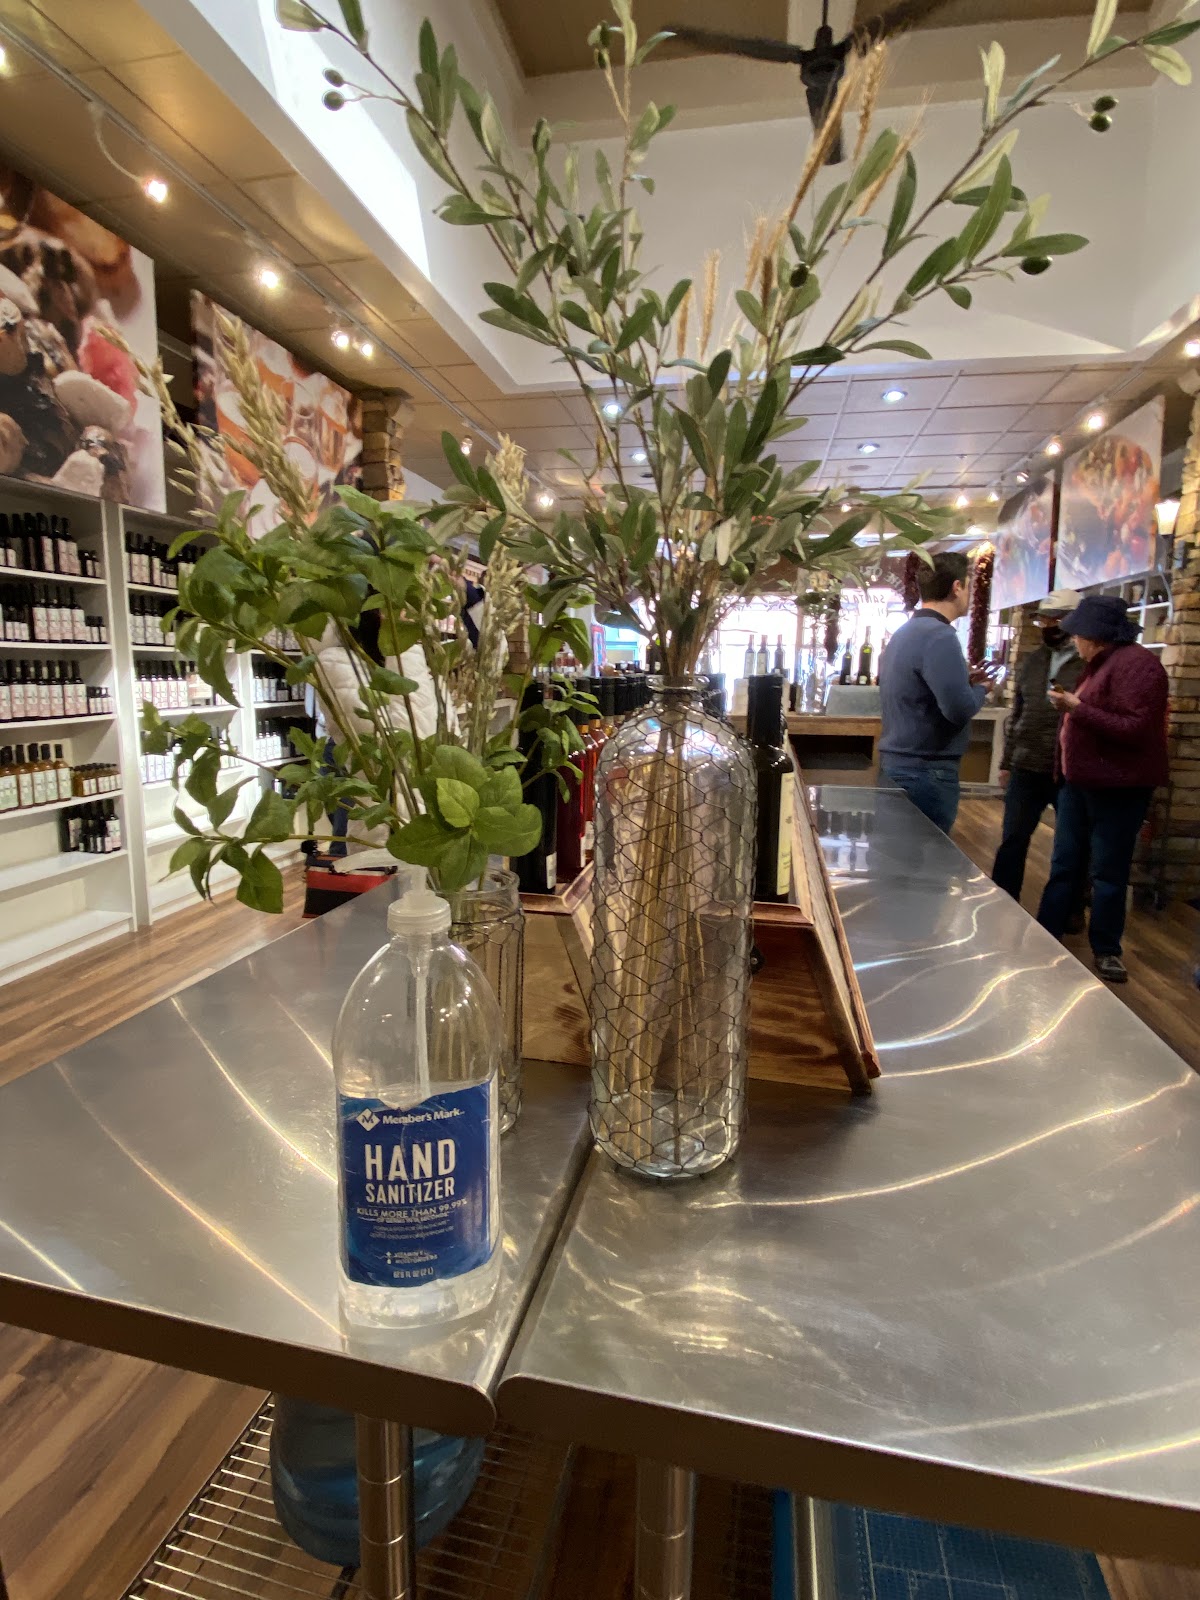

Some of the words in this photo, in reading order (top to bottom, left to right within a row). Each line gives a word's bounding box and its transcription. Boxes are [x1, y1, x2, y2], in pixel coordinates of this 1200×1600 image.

[382, 1112, 432, 1124] Member's
[433, 1107, 461, 1120] Mark
[364, 1138, 456, 1181] HAND
[365, 1176, 455, 1204] SANITIZER
[356, 1207, 379, 1217] KILLS
[380, 1209, 409, 1219] MORE
[411, 1206, 437, 1217] THAN
